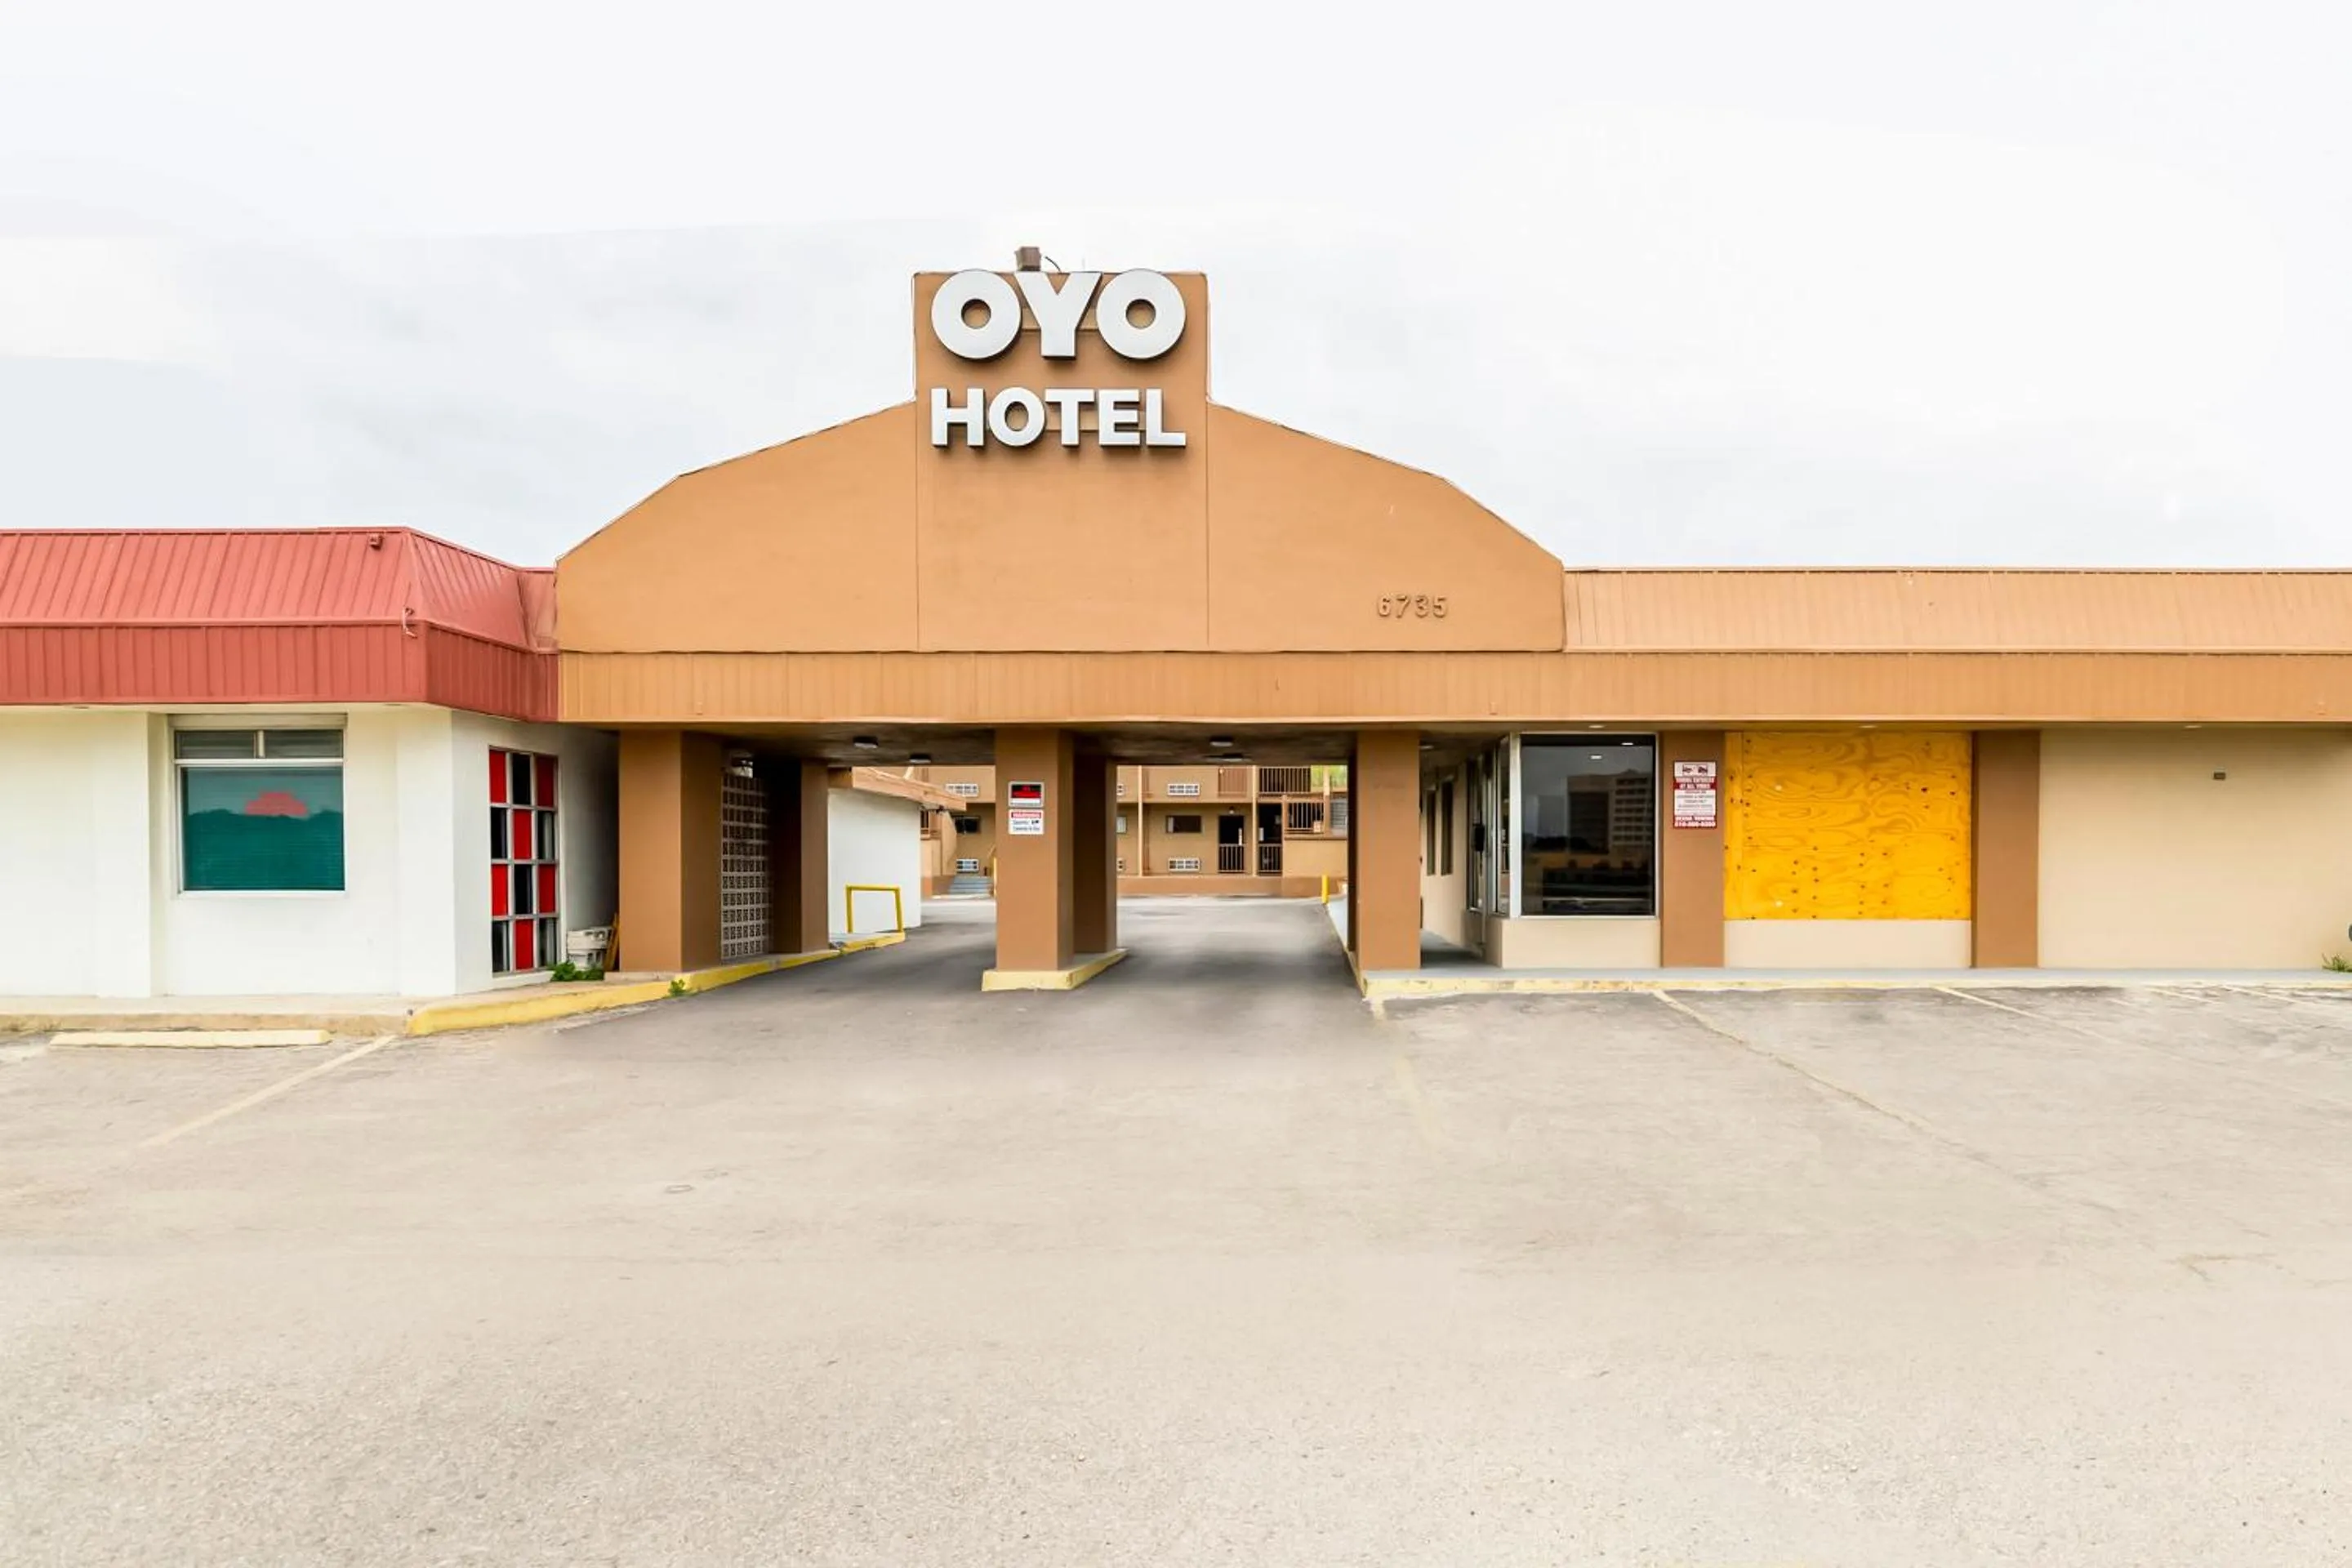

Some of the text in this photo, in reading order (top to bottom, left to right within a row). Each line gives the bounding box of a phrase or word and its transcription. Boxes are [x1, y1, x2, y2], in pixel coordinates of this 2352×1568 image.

[931, 269, 1186, 360] OYO
[931, 387, 1186, 447] HOTEL
[1378, 595, 1448, 618] 6735
